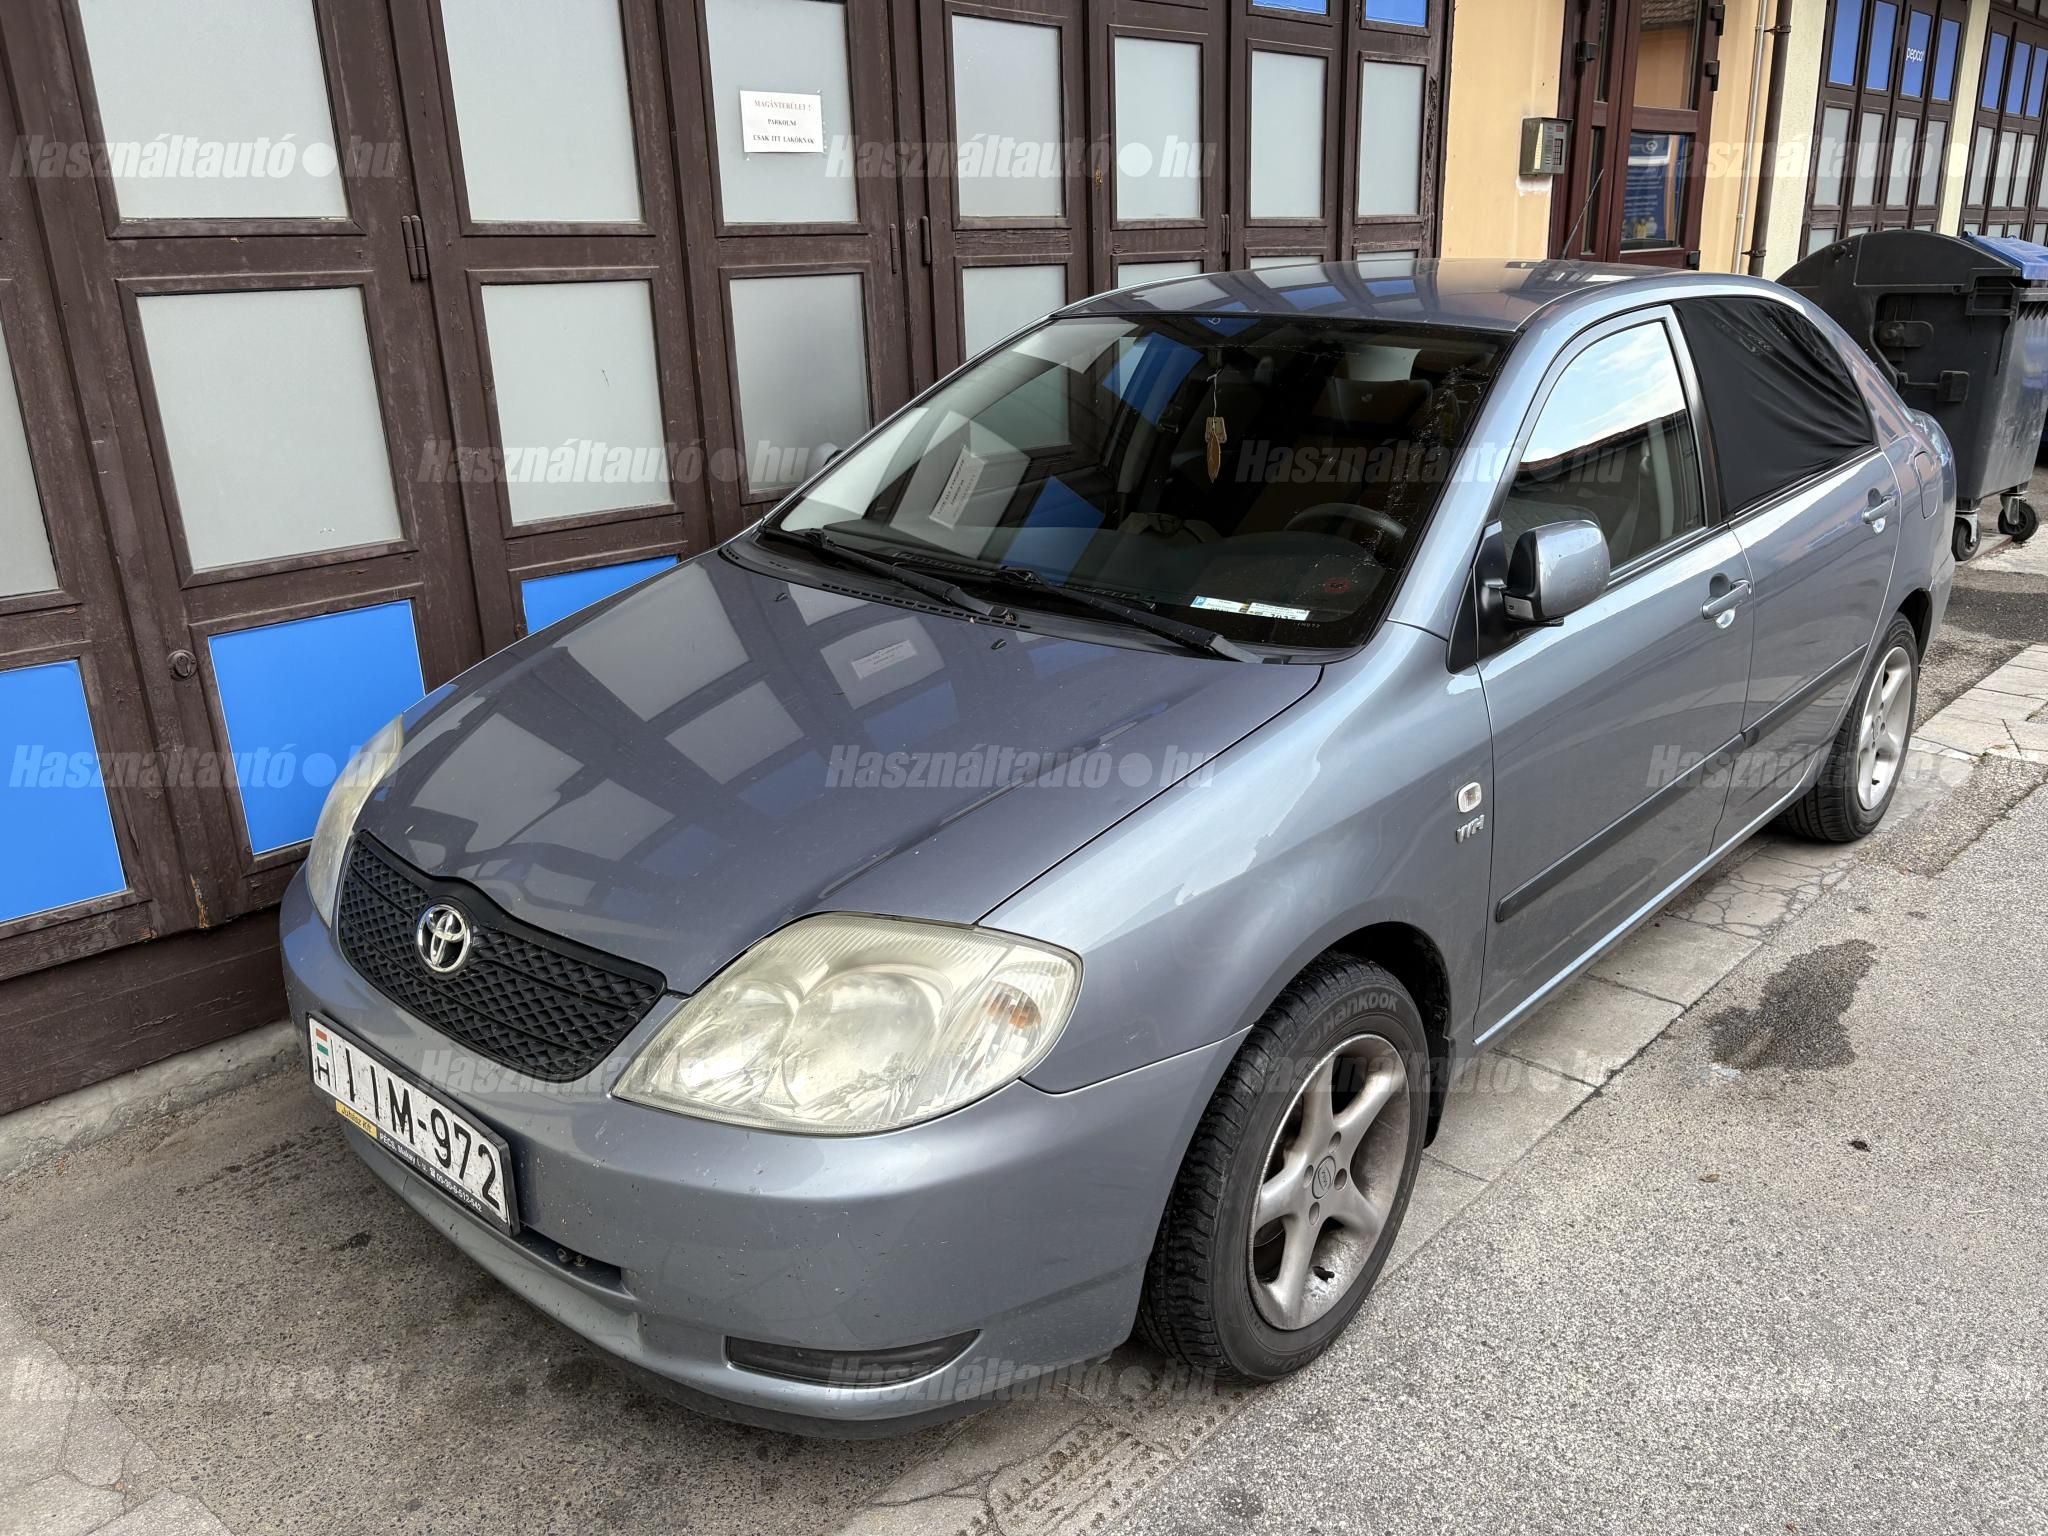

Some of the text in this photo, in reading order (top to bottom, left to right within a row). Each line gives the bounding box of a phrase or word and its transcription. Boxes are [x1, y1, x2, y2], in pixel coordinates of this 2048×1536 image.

[767, 118, 797, 127] PARKOLNI
[753, 134, 770, 142] CSAK
[316, 1055, 331, 1087] H
